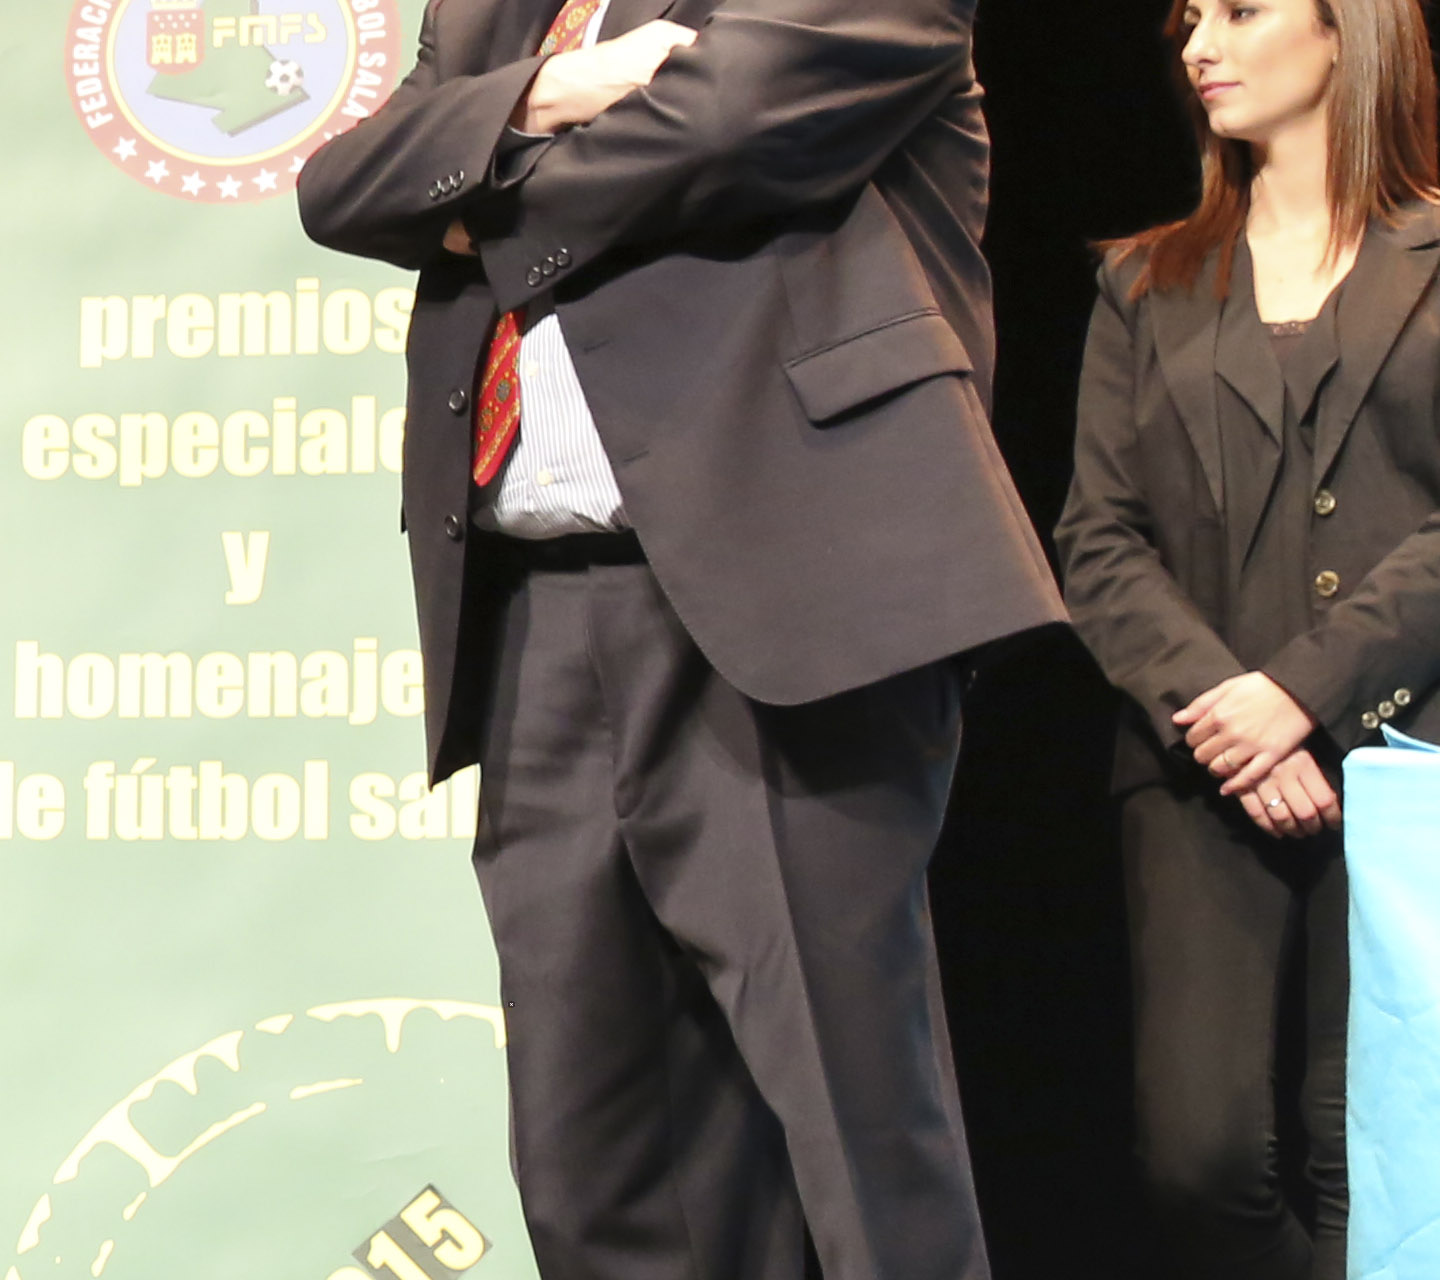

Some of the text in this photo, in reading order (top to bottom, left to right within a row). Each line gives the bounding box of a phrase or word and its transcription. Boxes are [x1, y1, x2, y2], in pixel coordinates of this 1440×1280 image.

[212, 13, 326, 48] FMFS
[341, 52, 386, 119] SALA
[79, 277, 416, 368] premios
[22, 395, 406, 486] especiale
[221, 530, 269, 604] y
[14, 637, 425, 725] homenaje
[83, 757, 328, 840] fútbol
[349, 765, 478, 841] sal
